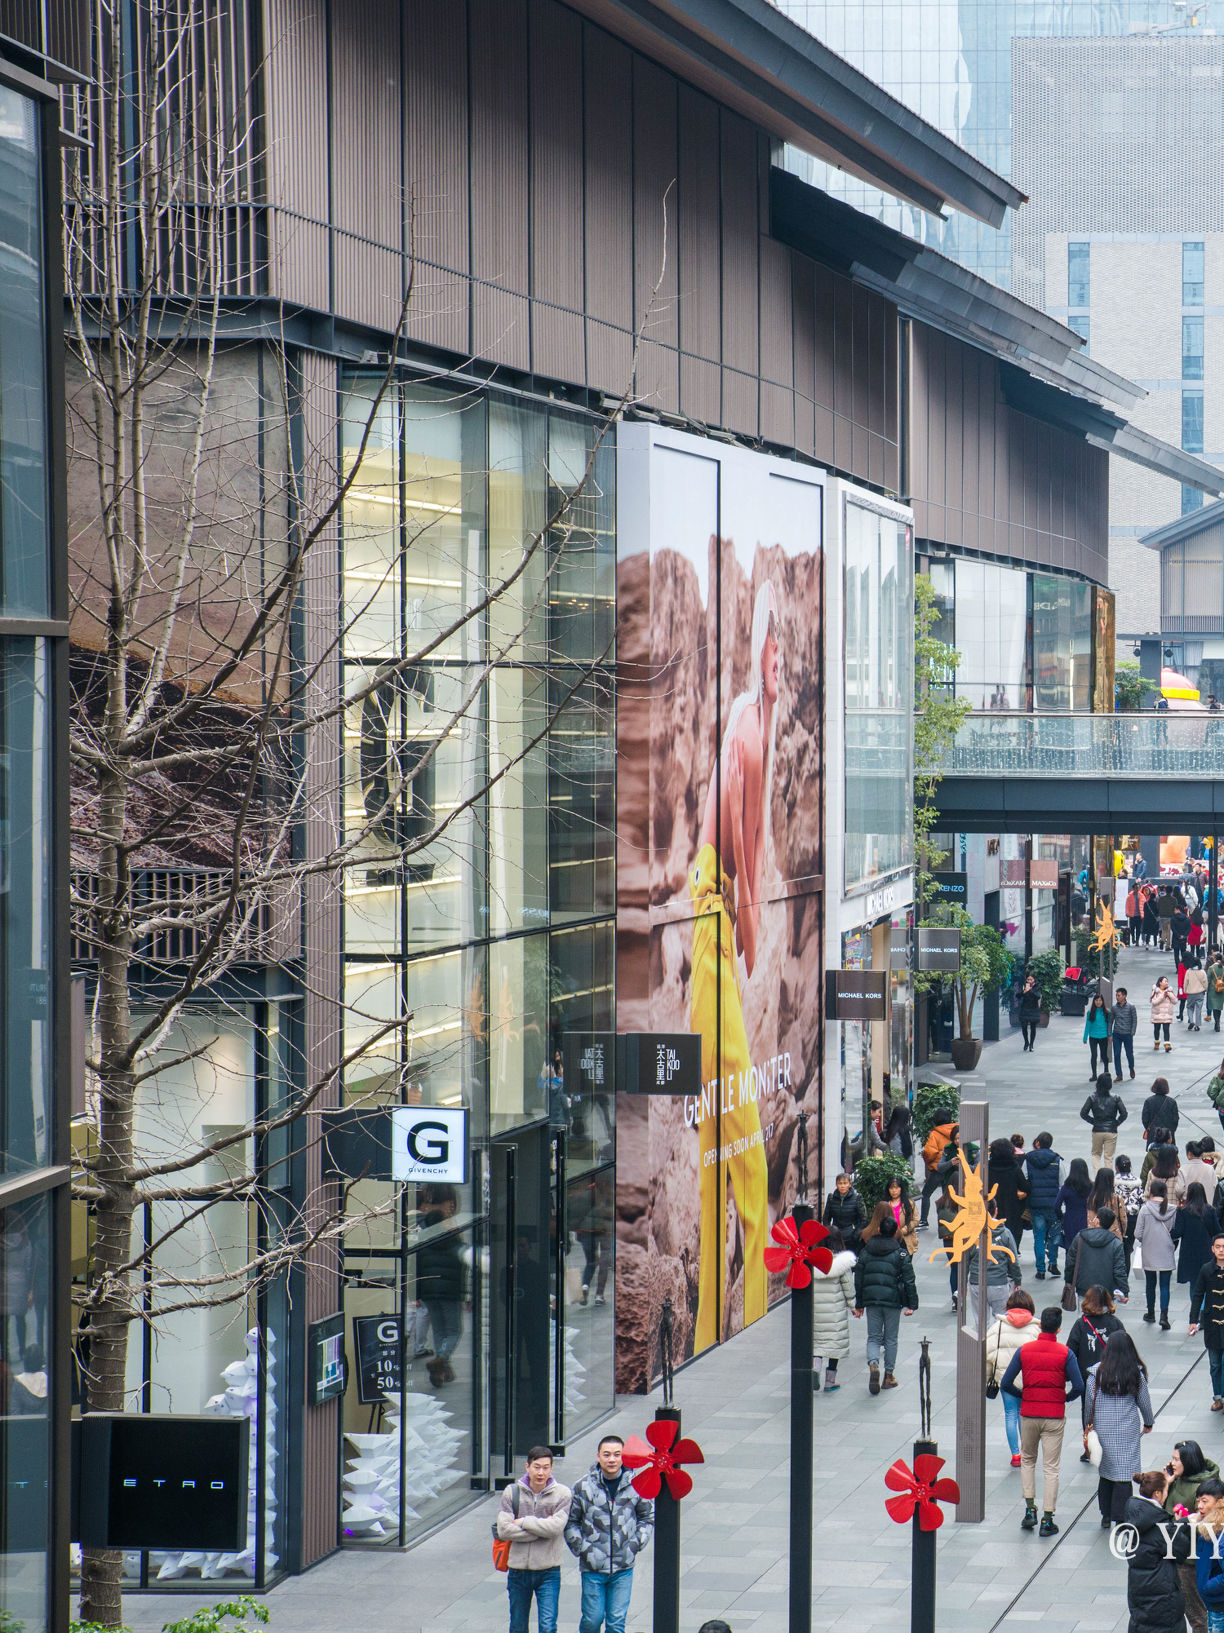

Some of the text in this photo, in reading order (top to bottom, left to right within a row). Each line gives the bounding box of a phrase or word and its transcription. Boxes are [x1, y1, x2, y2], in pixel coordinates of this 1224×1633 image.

[938, 884, 965, 893] KENZO
[666, 1048, 676, 1060] TAI
[656, 1048, 666, 1081] 太古里
[666, 1059, 680, 1071] KOO
[666, 1069, 673, 1081] LI
[684, 1073, 735, 1128] GENTLE
[407, 1121, 449, 1165] G
[733, 1137, 749, 1157] SOON
[377, 1321, 399, 1343] G
